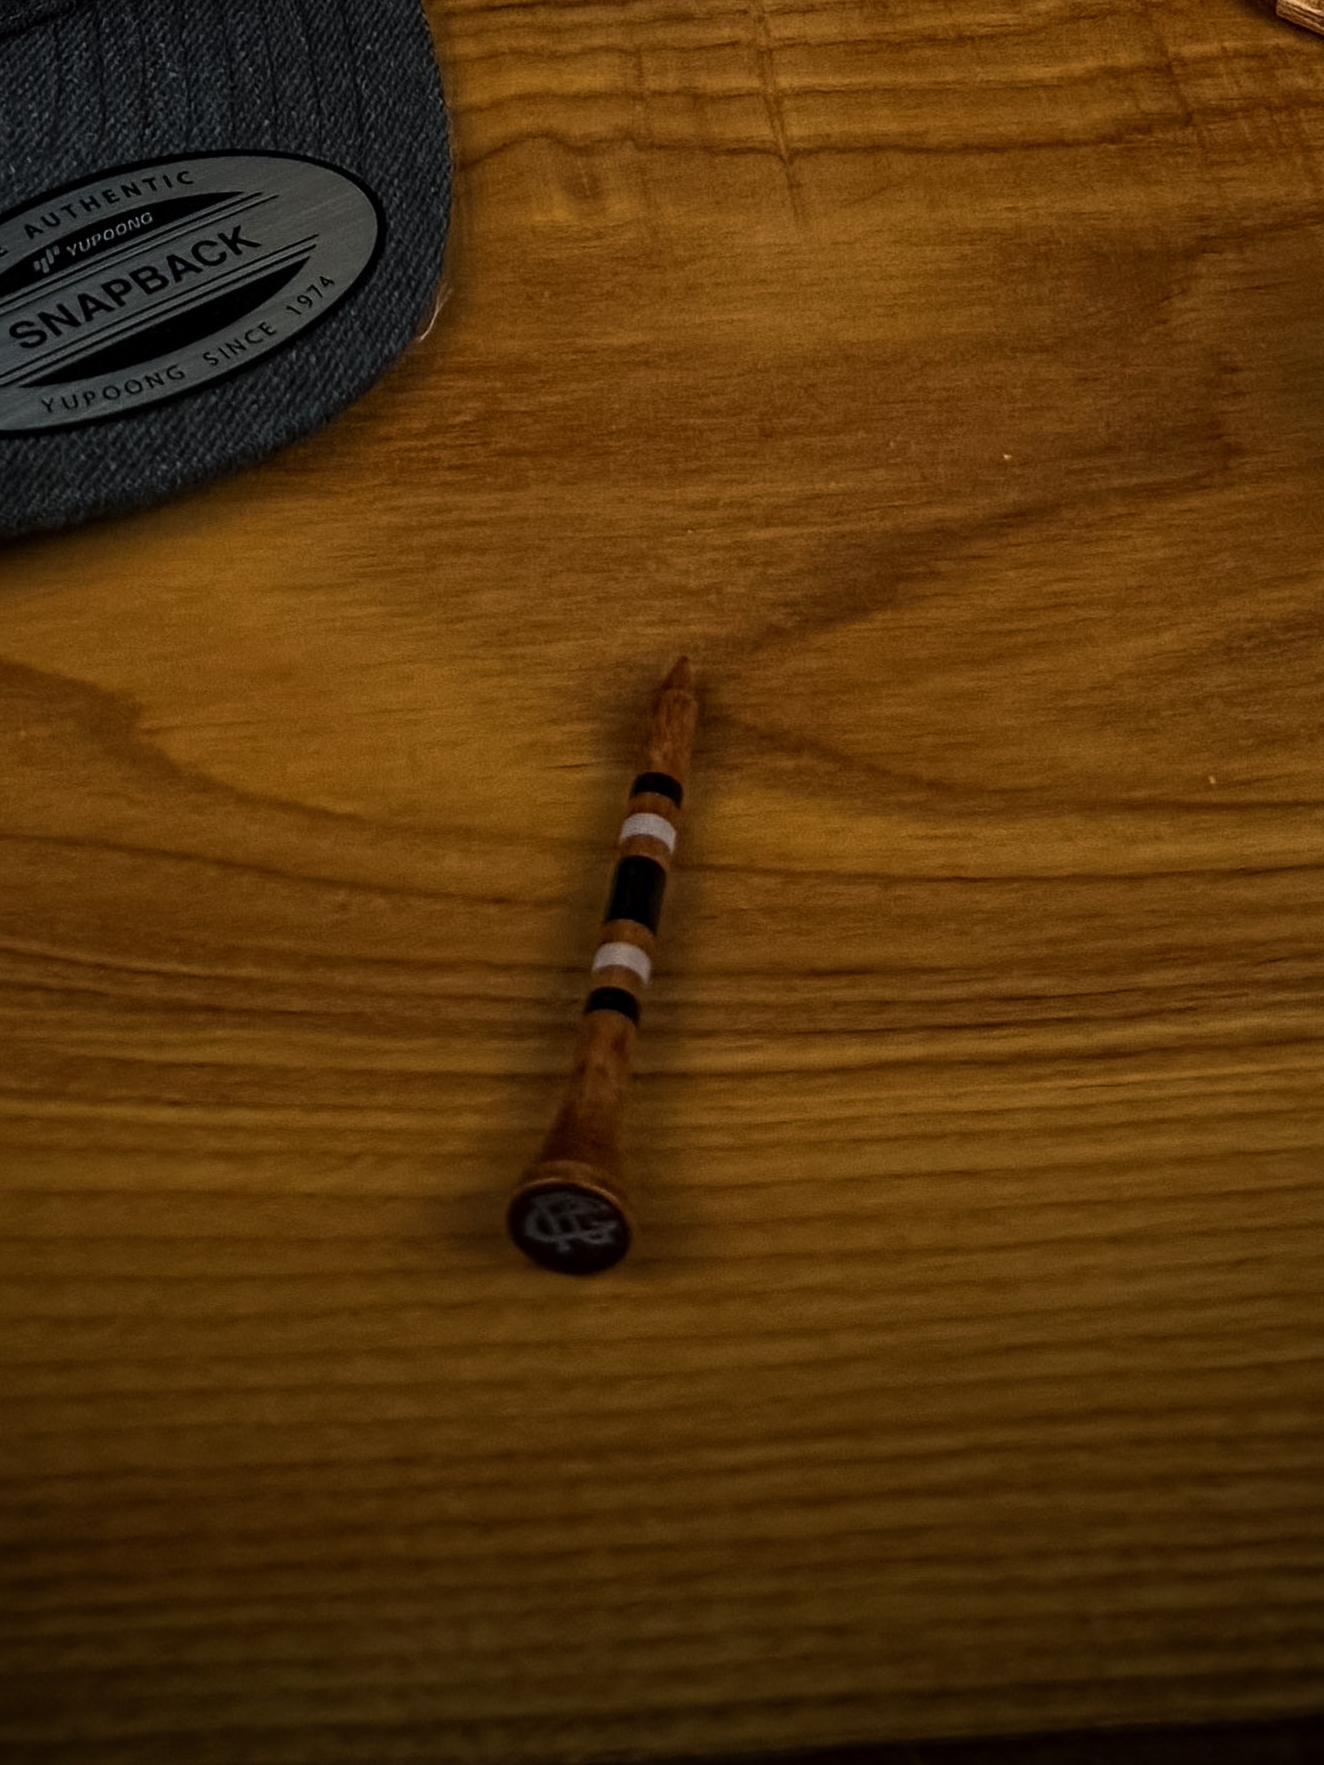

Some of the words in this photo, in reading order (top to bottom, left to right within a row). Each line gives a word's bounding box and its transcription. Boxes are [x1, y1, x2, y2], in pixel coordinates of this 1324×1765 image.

[23, 170, 196, 240] AUTHENTIC
[64, 210, 156, 258] YUPOONG
[8, 224, 262, 350] SNAPBACK
[39, 364, 187, 415] YUPOONG
[202, 323, 279, 367] SINCE
[285, 274, 335, 318] 1974
